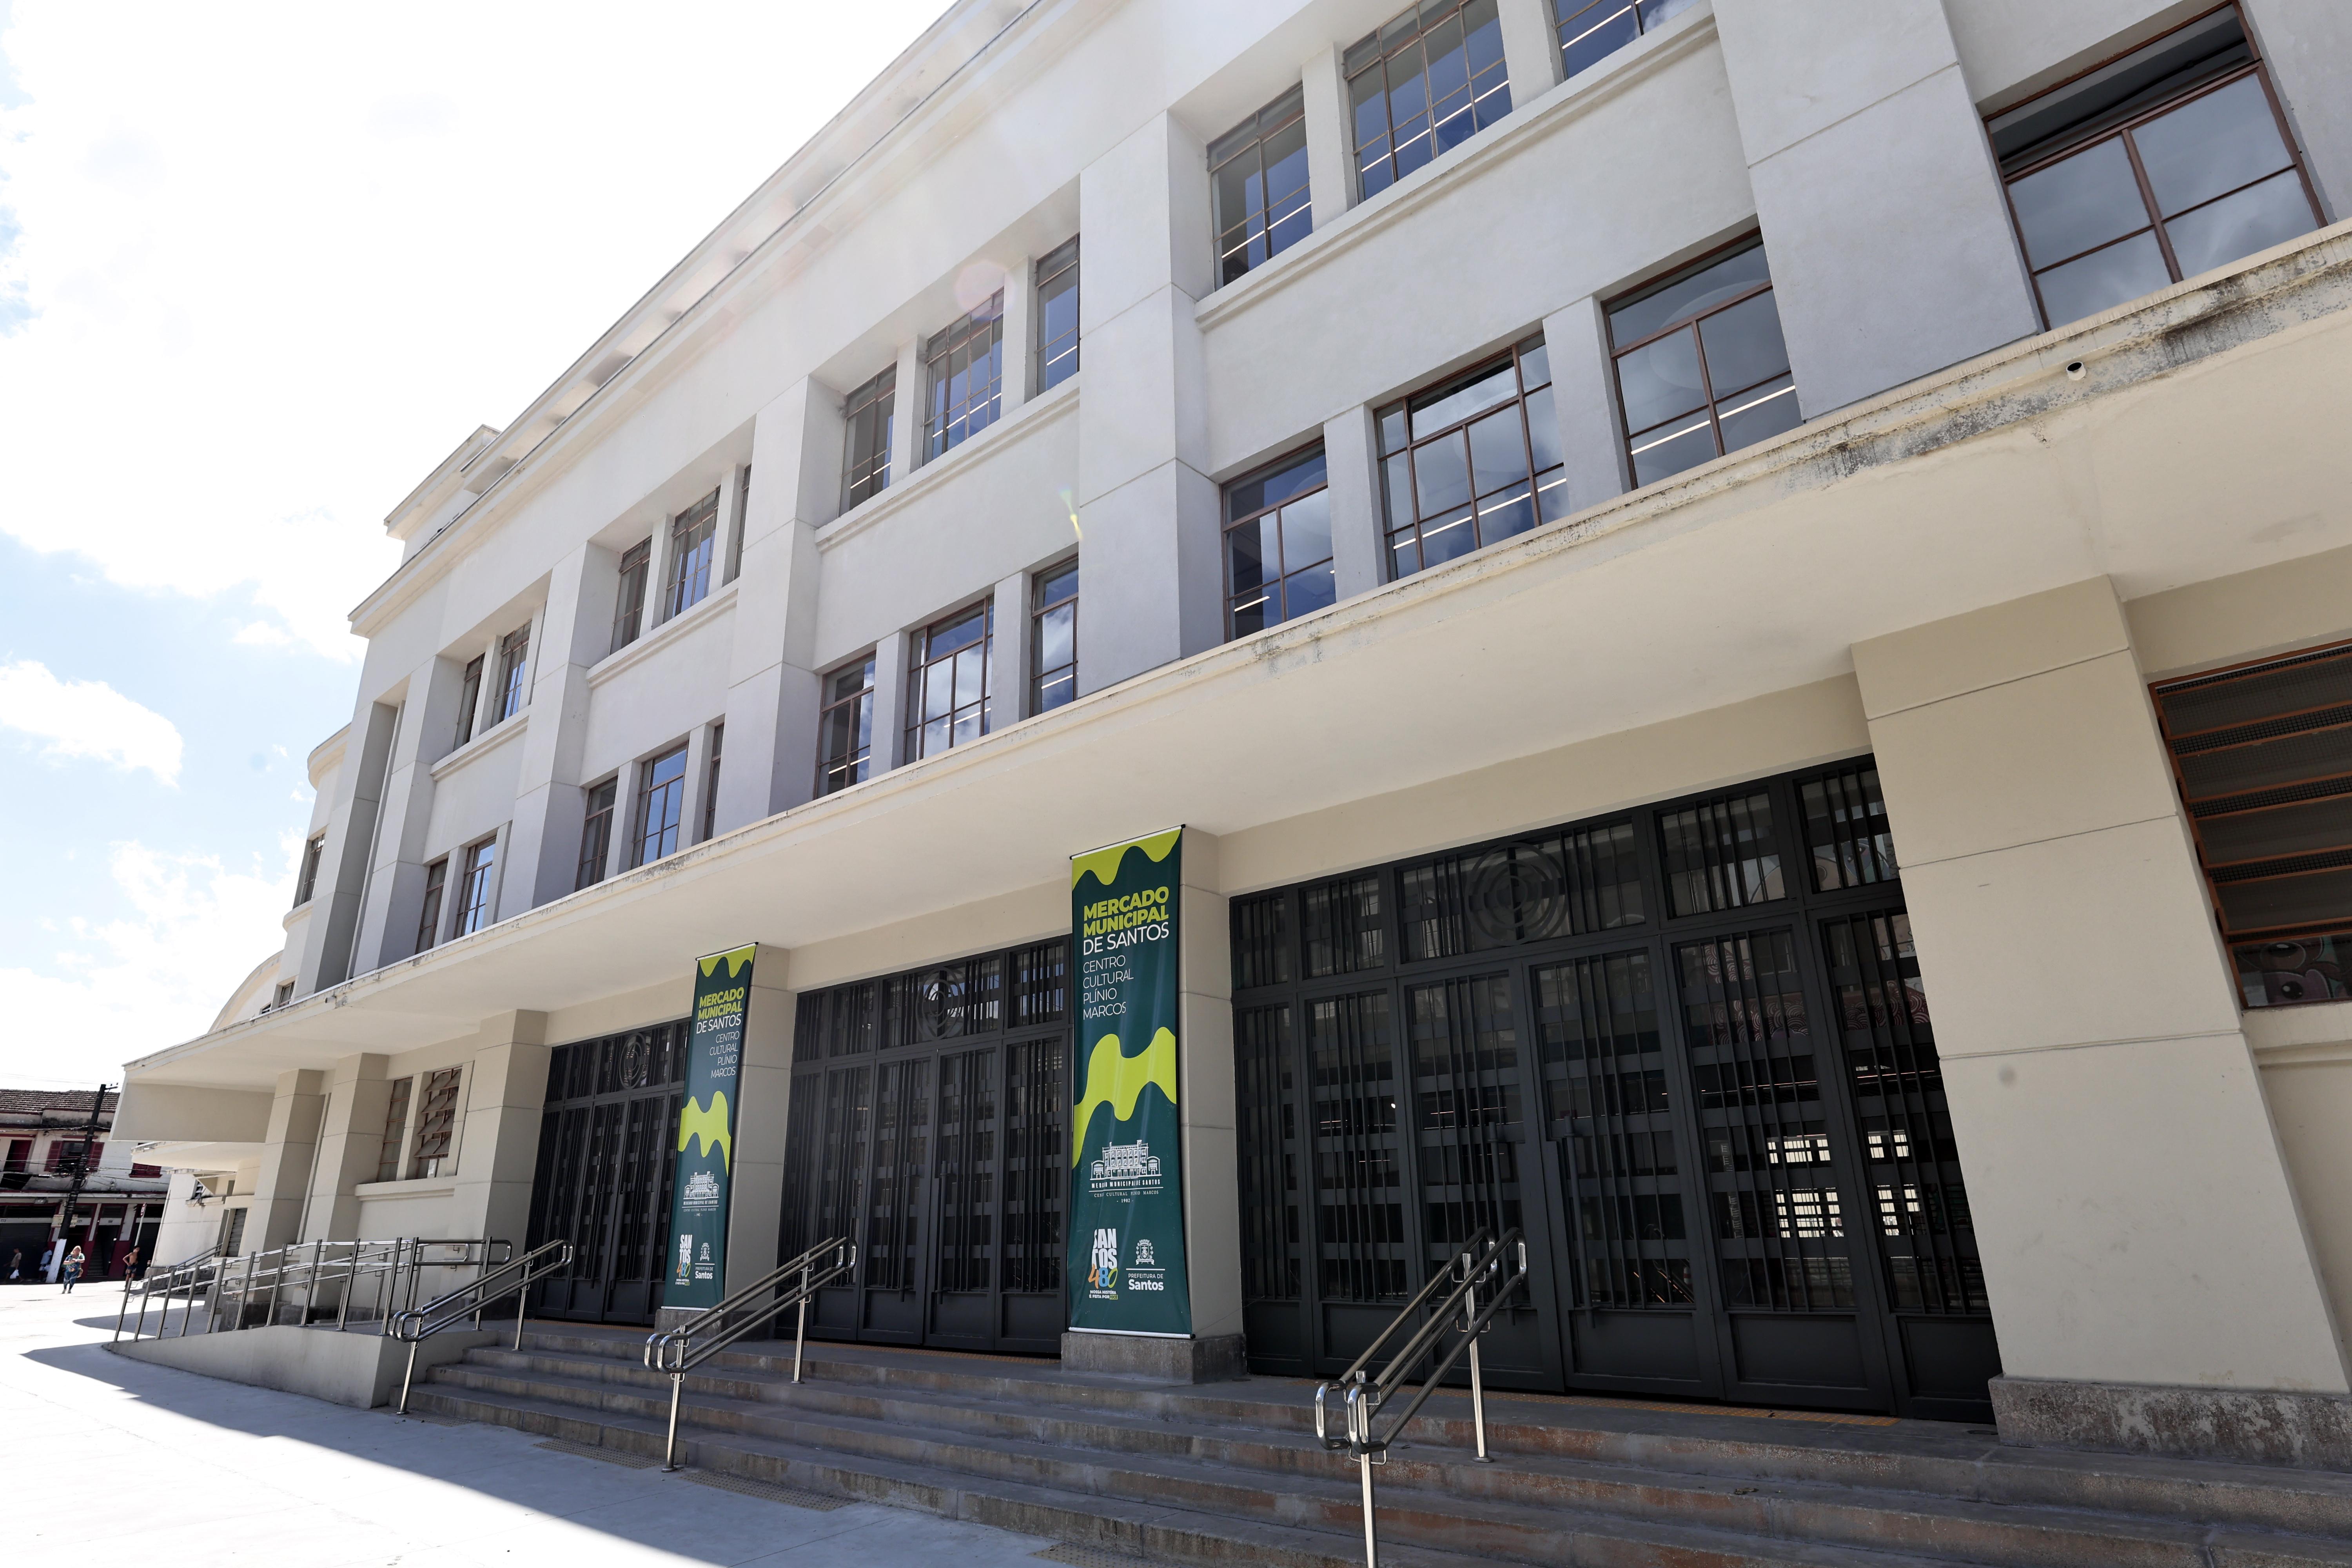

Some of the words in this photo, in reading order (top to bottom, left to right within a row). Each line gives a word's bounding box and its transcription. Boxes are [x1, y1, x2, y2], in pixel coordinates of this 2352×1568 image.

[1084, 886, 1169, 921] MERCADO
[1083, 906, 1169, 938] MUNICIPAL
[1083, 936, 1103, 955] DE
[1107, 922, 1169, 950] SANTOS
[1083, 955, 1125, 973] CENTRO
[1083, 969, 1134, 989] CULTURAL
[699, 987, 744, 1008] MERCADO
[1083, 987, 1117, 1004] PLÍNIO
[698, 1001, 742, 1020] MUNICIPAL
[1083, 1002, 1126, 1020] MARCOS
[696, 1020, 706, 1034] DE
[708, 1014, 741, 1032] SANTOS
[716, 1031, 740, 1043] CENTRO
[710, 1043, 738, 1055] CULTURAL
[717, 1054, 737, 1066] PLÍNIO
[711, 1066, 736, 1078] MARCOS
[680, 1234, 692, 1249] SAN
[1093, 1229, 1116, 1249] SAN
[679, 1249, 691, 1263] TOS
[1092, 1248, 1118, 1269] TOS
[677, 1261, 690, 1278] 480
[1088, 1264, 1118, 1289] 480
[1129, 1279, 1164, 1291] Santos
